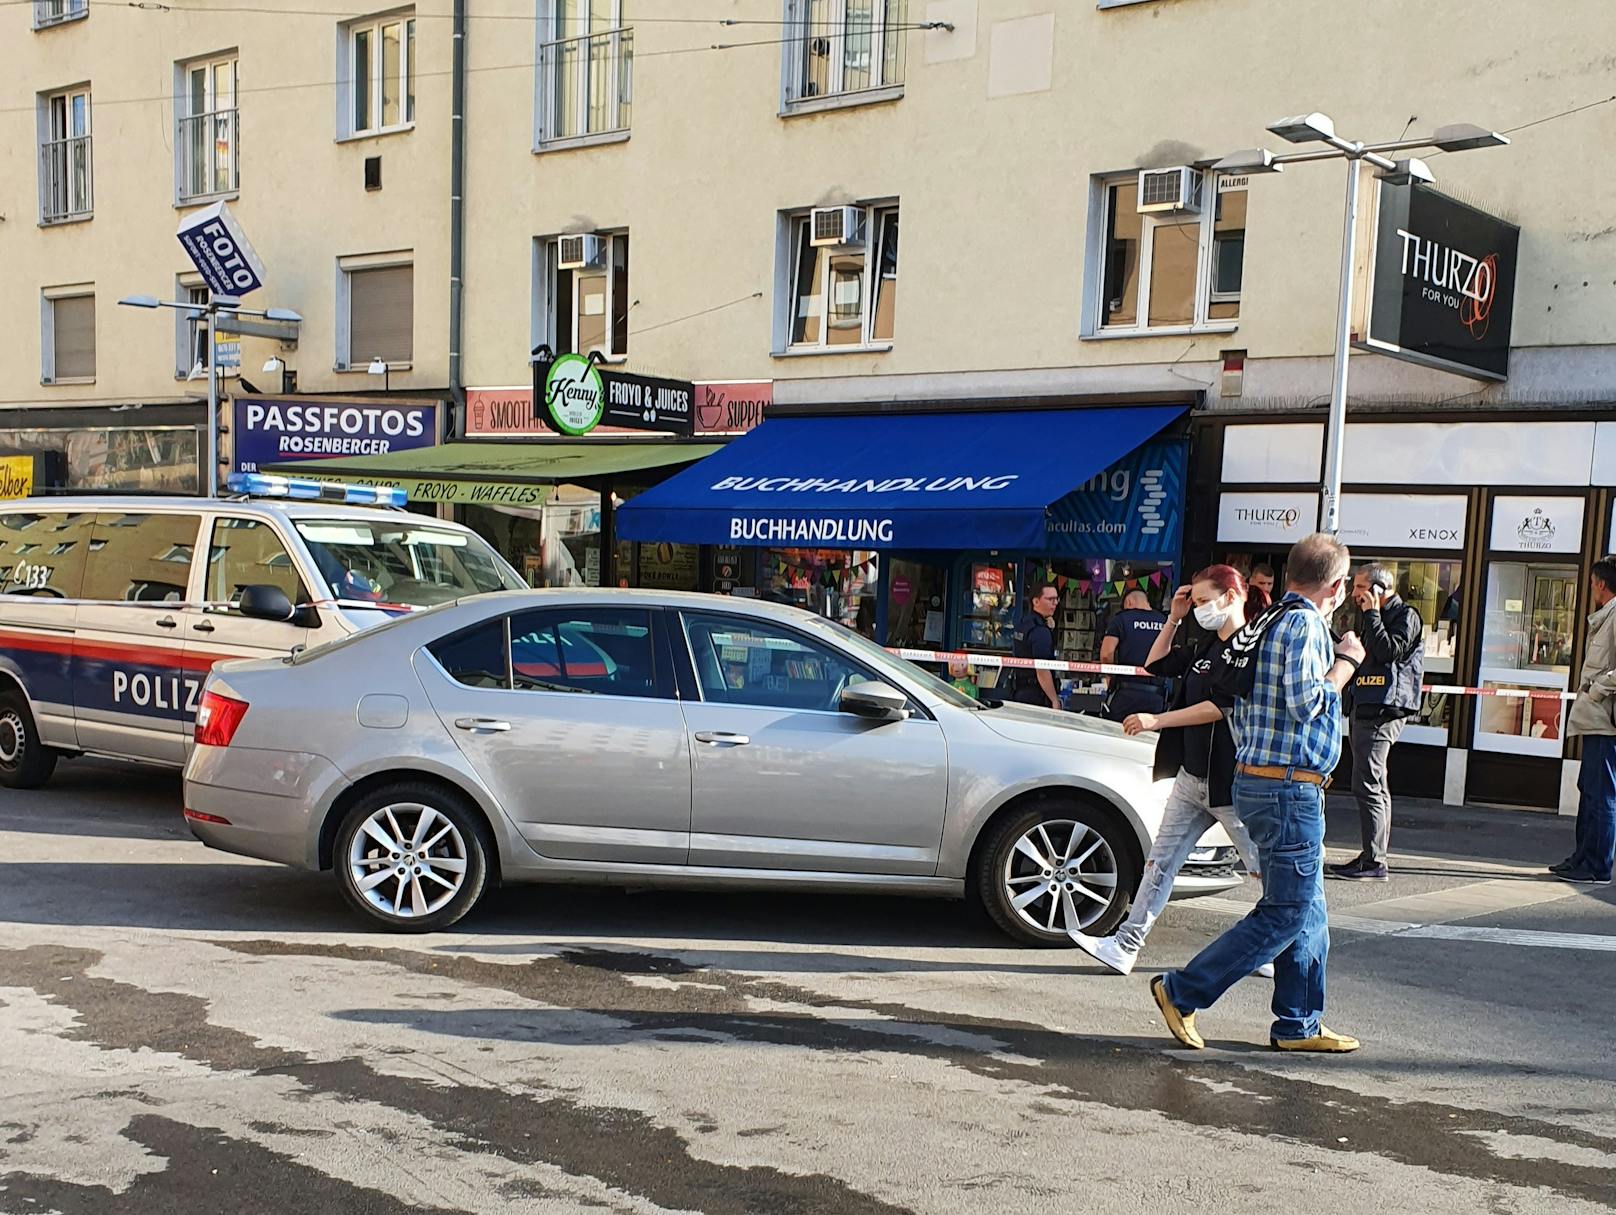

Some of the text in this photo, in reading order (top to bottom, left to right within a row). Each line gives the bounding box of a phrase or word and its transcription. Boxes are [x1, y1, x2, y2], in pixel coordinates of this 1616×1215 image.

[195, 235, 234, 290] ROSENBERGER
[203, 221, 254, 289] FOTO
[1396, 228, 1491, 302] THURZO
[1422, 287, 1460, 309] FOR YOU
[610, 382, 690, 412] FROYO & JUICES
[246, 404, 424, 437] PASSFOTOS
[279, 436, 391, 456] ROSENBERGER
[241, 462, 258, 473] DER
[0, 465, 28, 499] elber
[413, 482, 459, 500] FROYO
[470, 485, 541, 504] WAFFLES
[710, 474, 1019, 493] BUCHHANDLUNG
[1235, 508, 1298, 522] THURZO
[730, 516, 894, 543] BUCHHANDLUNG
[1409, 529, 1458, 542] XENOX
[25, 565, 49, 588] 133
[113, 669, 200, 714] POLIZ
[1356, 675, 1386, 687] OLIZEI
